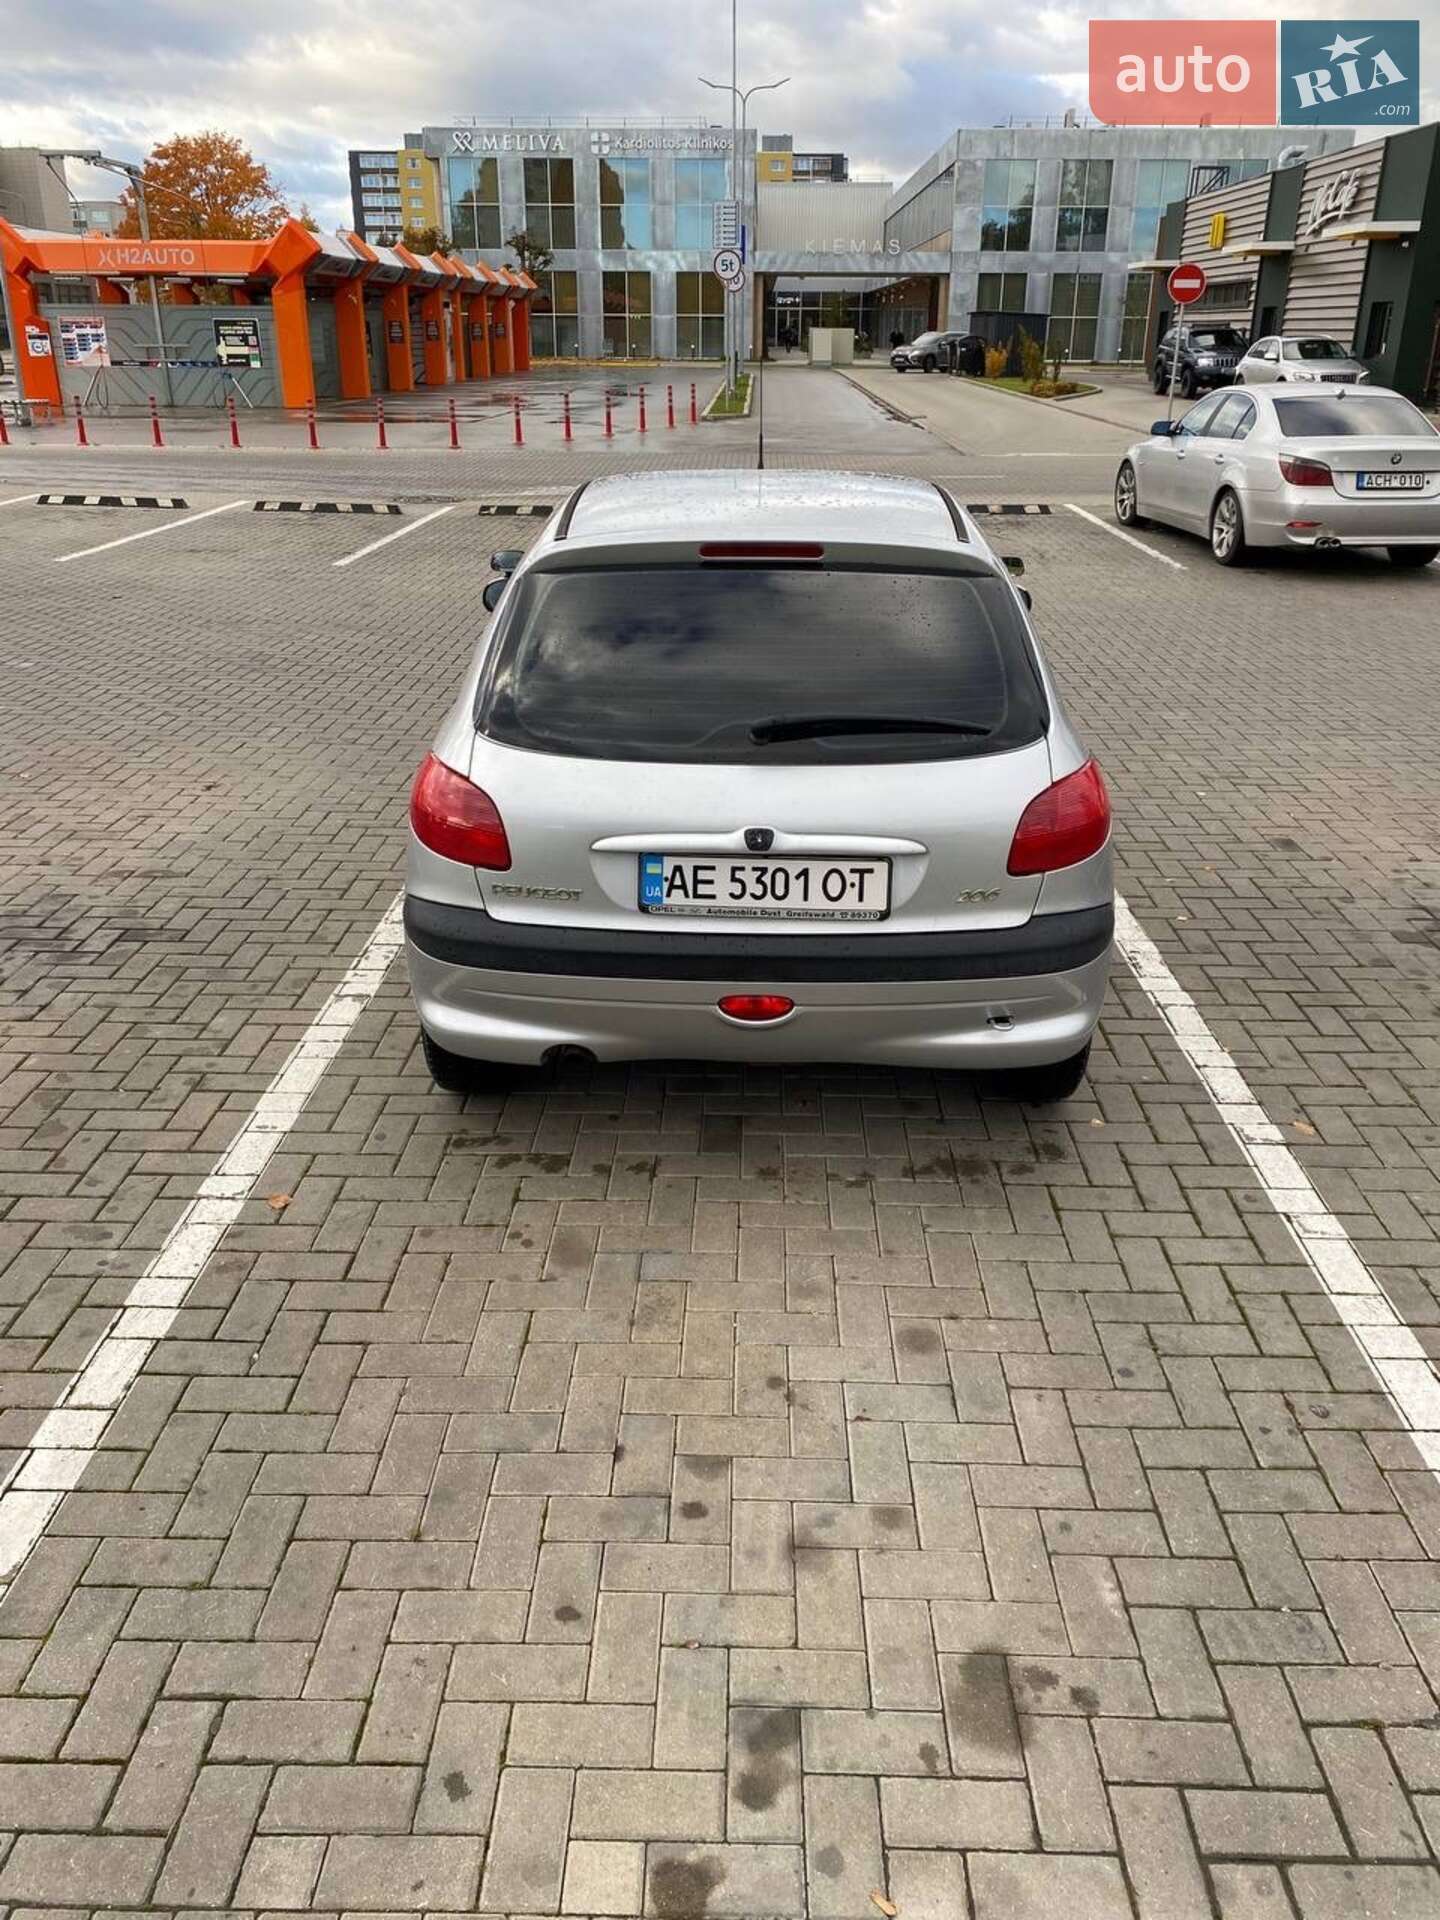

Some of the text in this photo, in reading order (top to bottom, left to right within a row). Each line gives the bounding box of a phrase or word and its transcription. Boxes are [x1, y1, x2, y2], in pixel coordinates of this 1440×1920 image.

[481, 134, 565, 151] MELIVA
[614, 135, 734, 150] Kardiolitos Klinikos
[805, 239, 901, 255] KIEMAS
[720, 259, 735, 272] 5t
[1366, 474, 1422, 486] ACH 010
[665, 864, 875, 903] AE 5301 OT
[645, 885, 662, 898] UA
